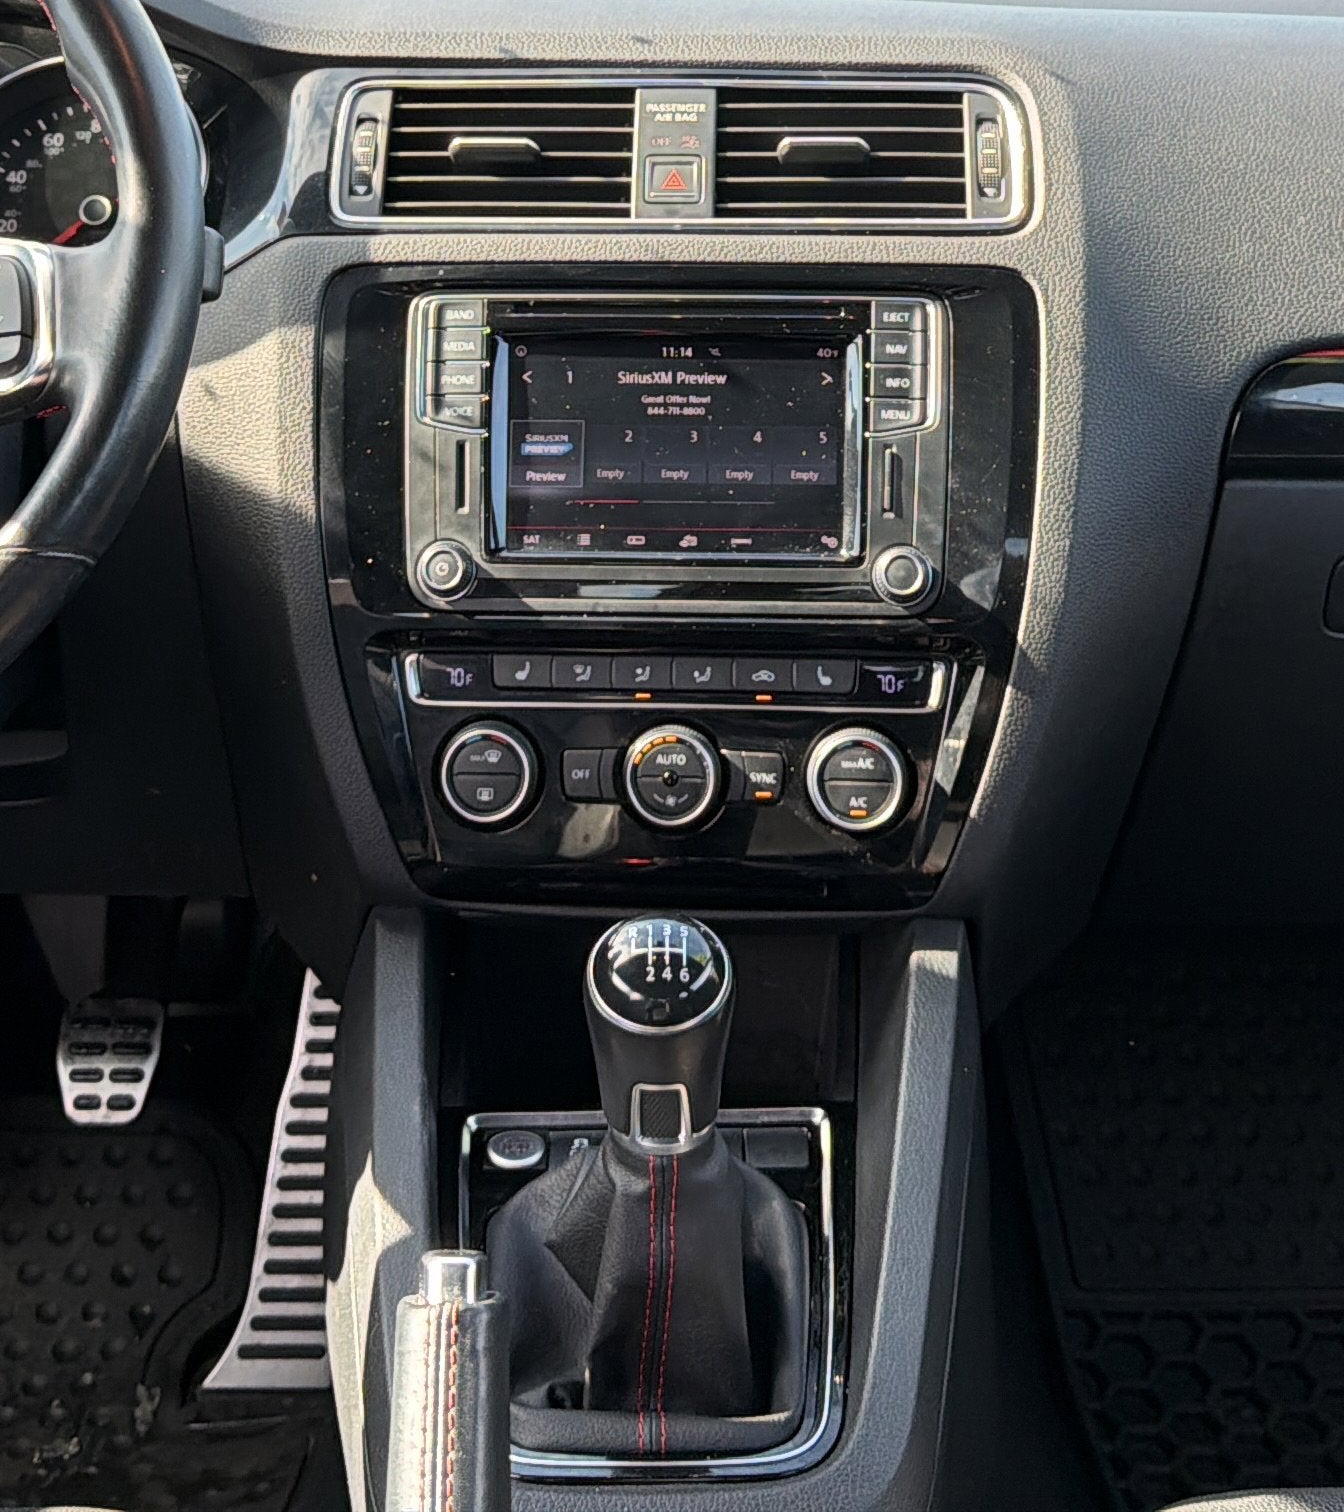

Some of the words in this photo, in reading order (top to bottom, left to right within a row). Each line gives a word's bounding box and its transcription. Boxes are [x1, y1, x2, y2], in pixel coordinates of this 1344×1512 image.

[645, 103, 707, 113] PASSENGER
[654, 112, 673, 122] AIR
[675, 112, 698, 122] BAG
[42, 132, 65, 147] 60
[5, 169, 27, 184] 40
[445, 310, 474, 320] BAND
[882, 312, 910, 323] EJECT
[443, 341, 476, 352] MEDIA
[661, 346, 693, 358] 11:14
[885, 344, 908, 354] NAV
[441, 374, 476, 385] PHONE
[566, 370, 573, 384] 1
[617, 370, 673, 384] SiriusXM
[676, 371, 727, 385] Preview
[885, 378, 911, 388] INFO
[641, 394, 664, 404] Great
[665, 394, 687, 404] Offer
[444, 406, 474, 417] VOICE
[881, 409, 911, 420] MENU
[624, 430, 634, 443] 2
[689, 430, 698, 443] 3
[752, 430, 763, 443] 4
[819, 431, 828, 444] 5
[525, 470, 567, 482] Preview
[596, 468, 625, 480] Empty
[660, 468, 689, 480] Empty
[724, 468, 754, 481] Empty
[789, 469, 820, 482] Empty
[522, 534, 540, 544] SAT
[655, 752, 687, 766] AUTO
[857, 757, 875, 770] A/C
[571, 769, 590, 780] OFF
[749, 772, 777, 785] SYNC
[849, 796, 868, 808] A/C
[628, 926, 638, 938] R
[662, 924, 671, 936] 3
[645, 966, 656, 982] 2
[661, 966, 673, 982] 4
[679, 967, 690, 983] 6
